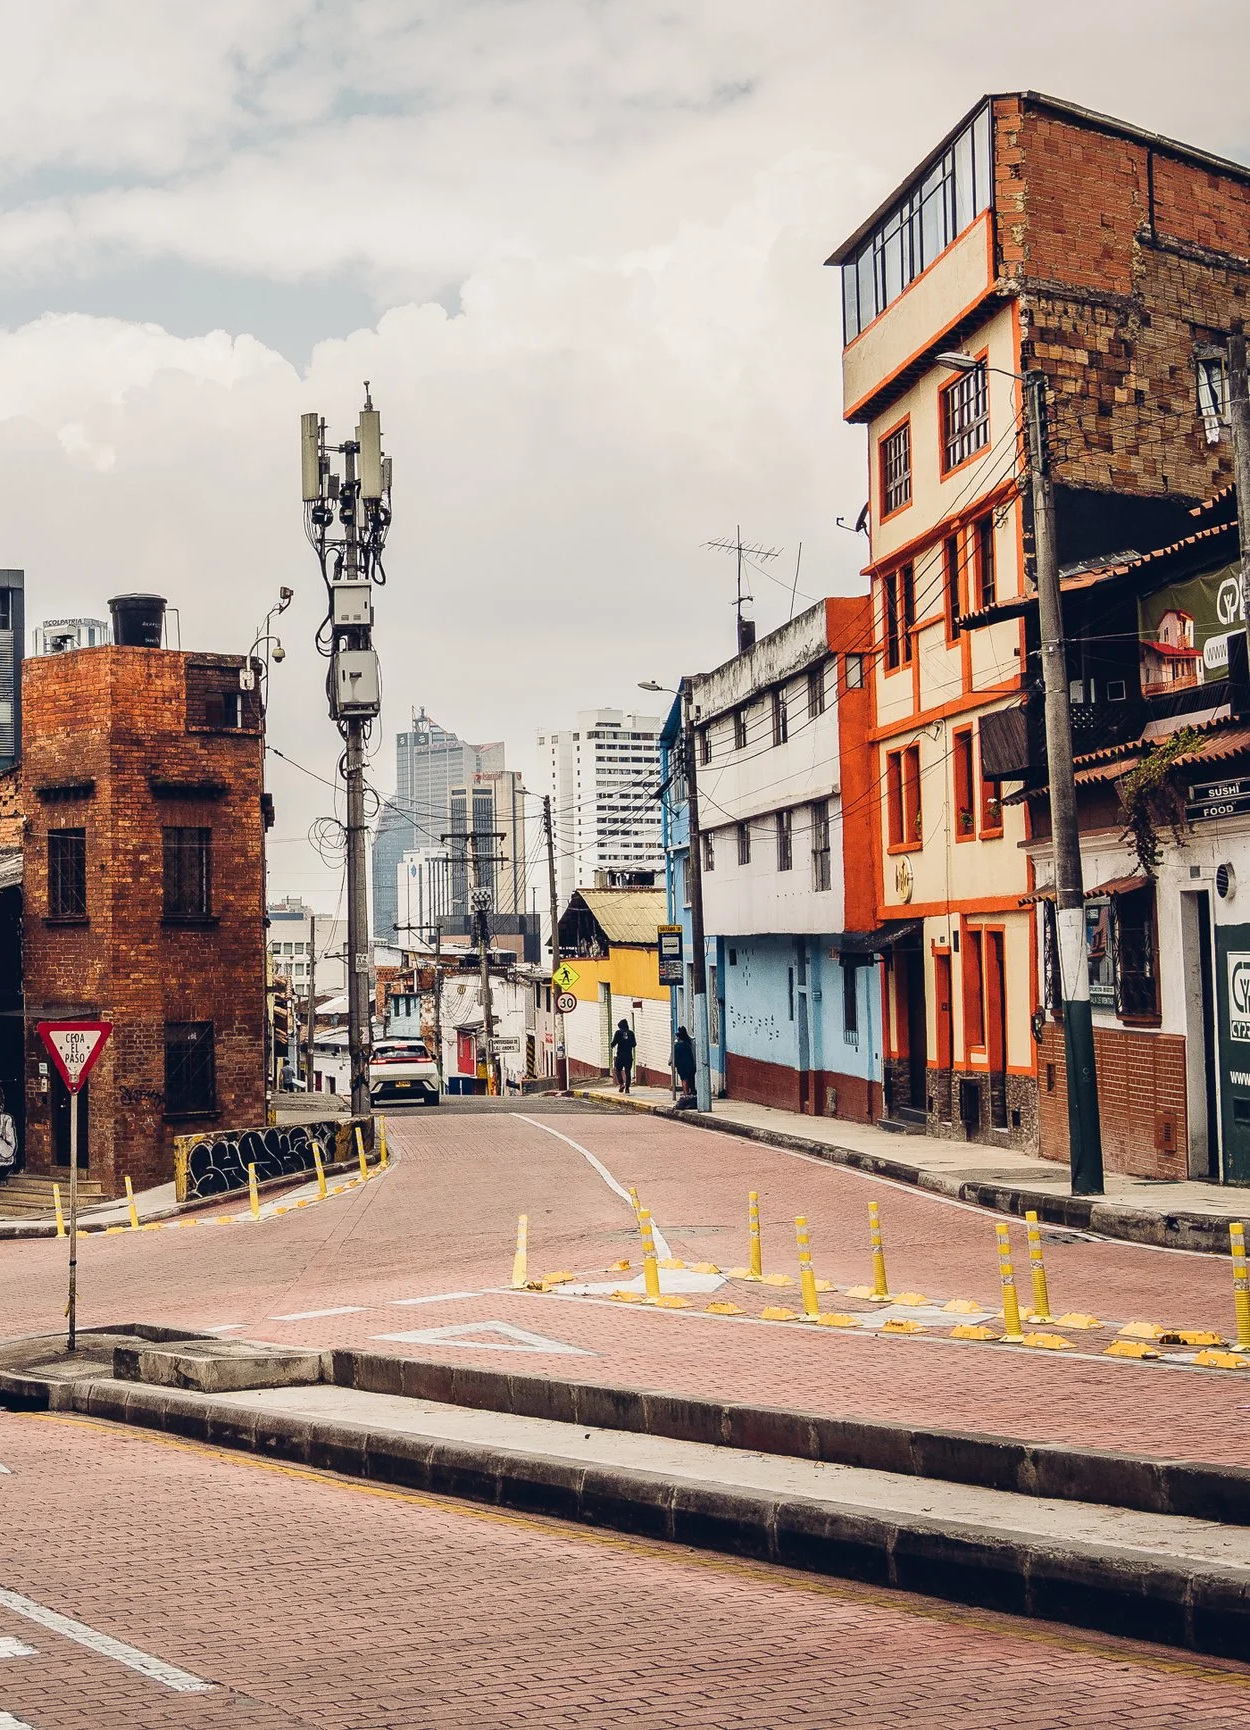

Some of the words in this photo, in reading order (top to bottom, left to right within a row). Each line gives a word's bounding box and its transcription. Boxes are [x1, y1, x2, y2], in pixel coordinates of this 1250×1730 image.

[1208, 785, 1239, 797] SUSHI
[1203, 805, 1234, 817] FOOD
[560, 998, 573, 1008] 30
[65, 1033, 85, 1044] CEDA
[70, 1043, 79, 1053] EL
[65, 1053, 85, 1063] PASO
